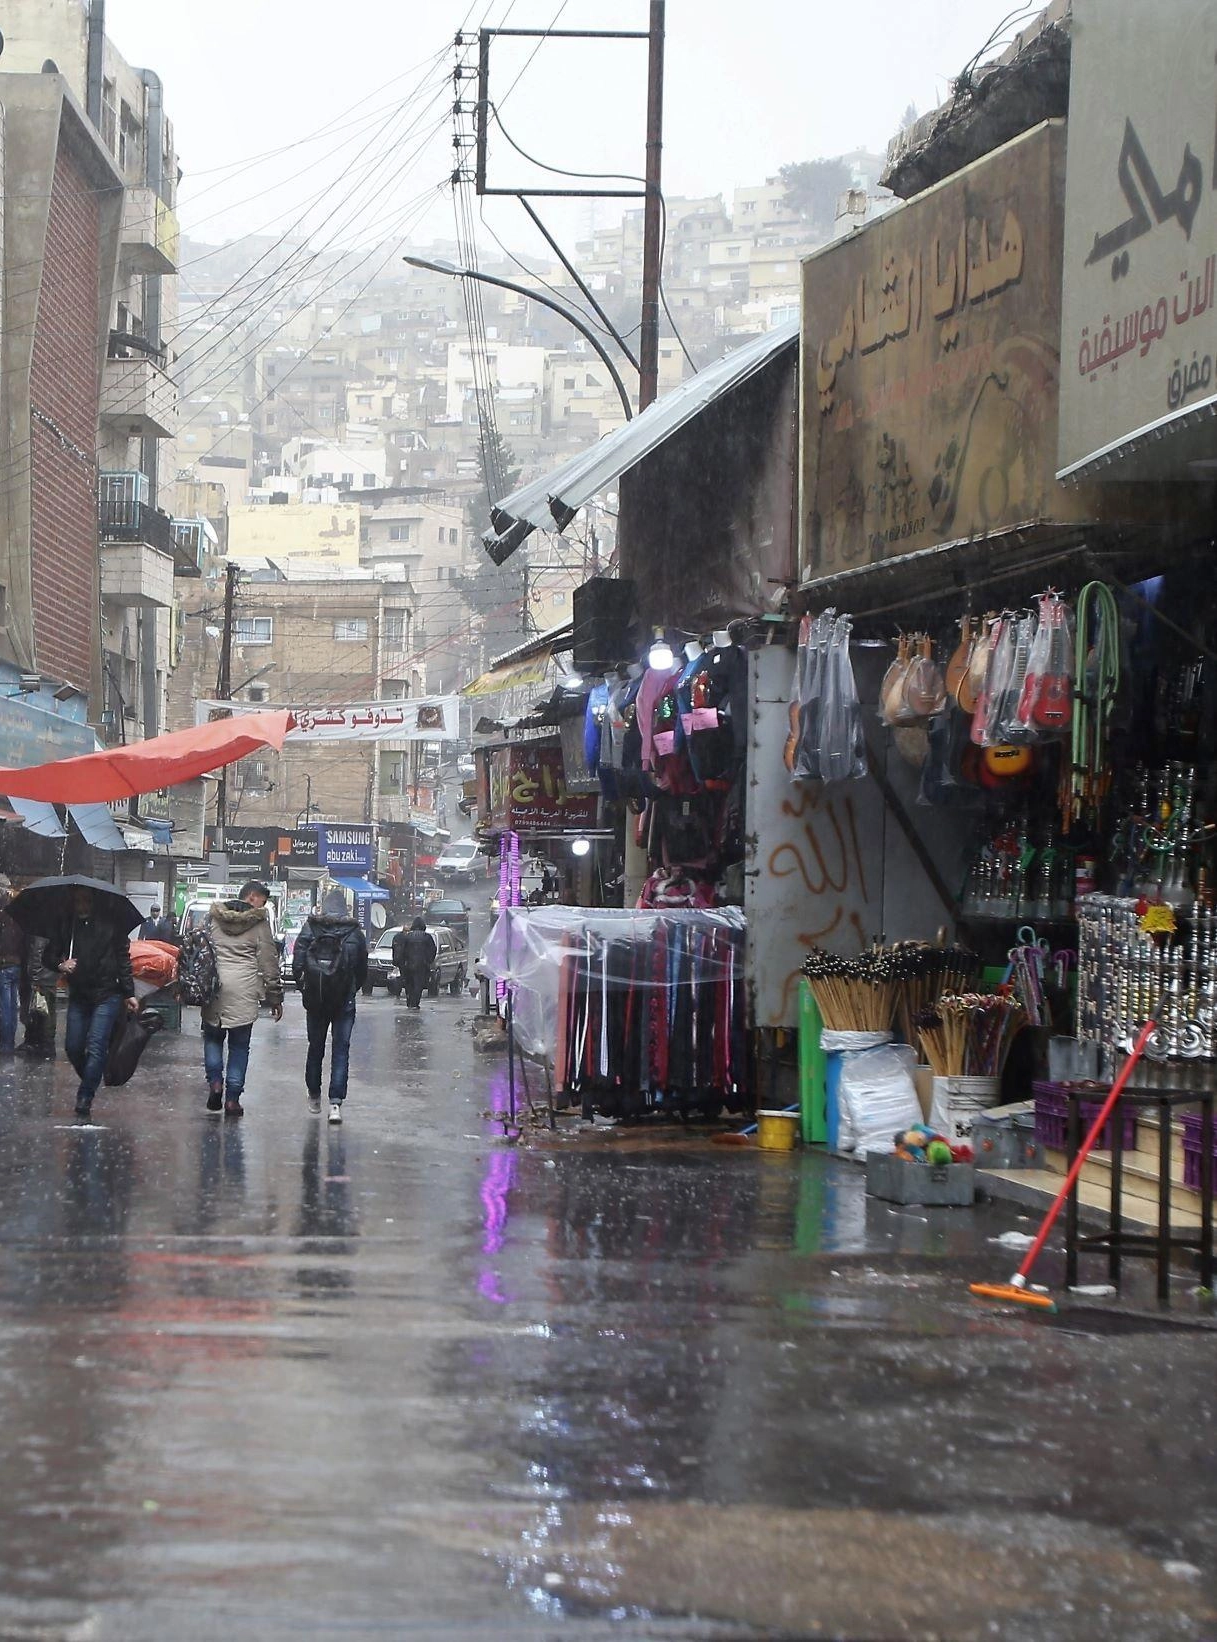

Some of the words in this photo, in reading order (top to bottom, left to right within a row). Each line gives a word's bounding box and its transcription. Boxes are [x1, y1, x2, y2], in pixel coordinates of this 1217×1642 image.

[933, 209, 1025, 353] هدايا
[817, 249, 924, 416] الشامي
[1078, 296, 1168, 382] موسيقية
[1167, 350, 1212, 409] مفرق
[351, 707, 404, 729] تذوقو
[244, 839, 265, 850] دريم
[326, 831, 371, 846] SAMSUNG
